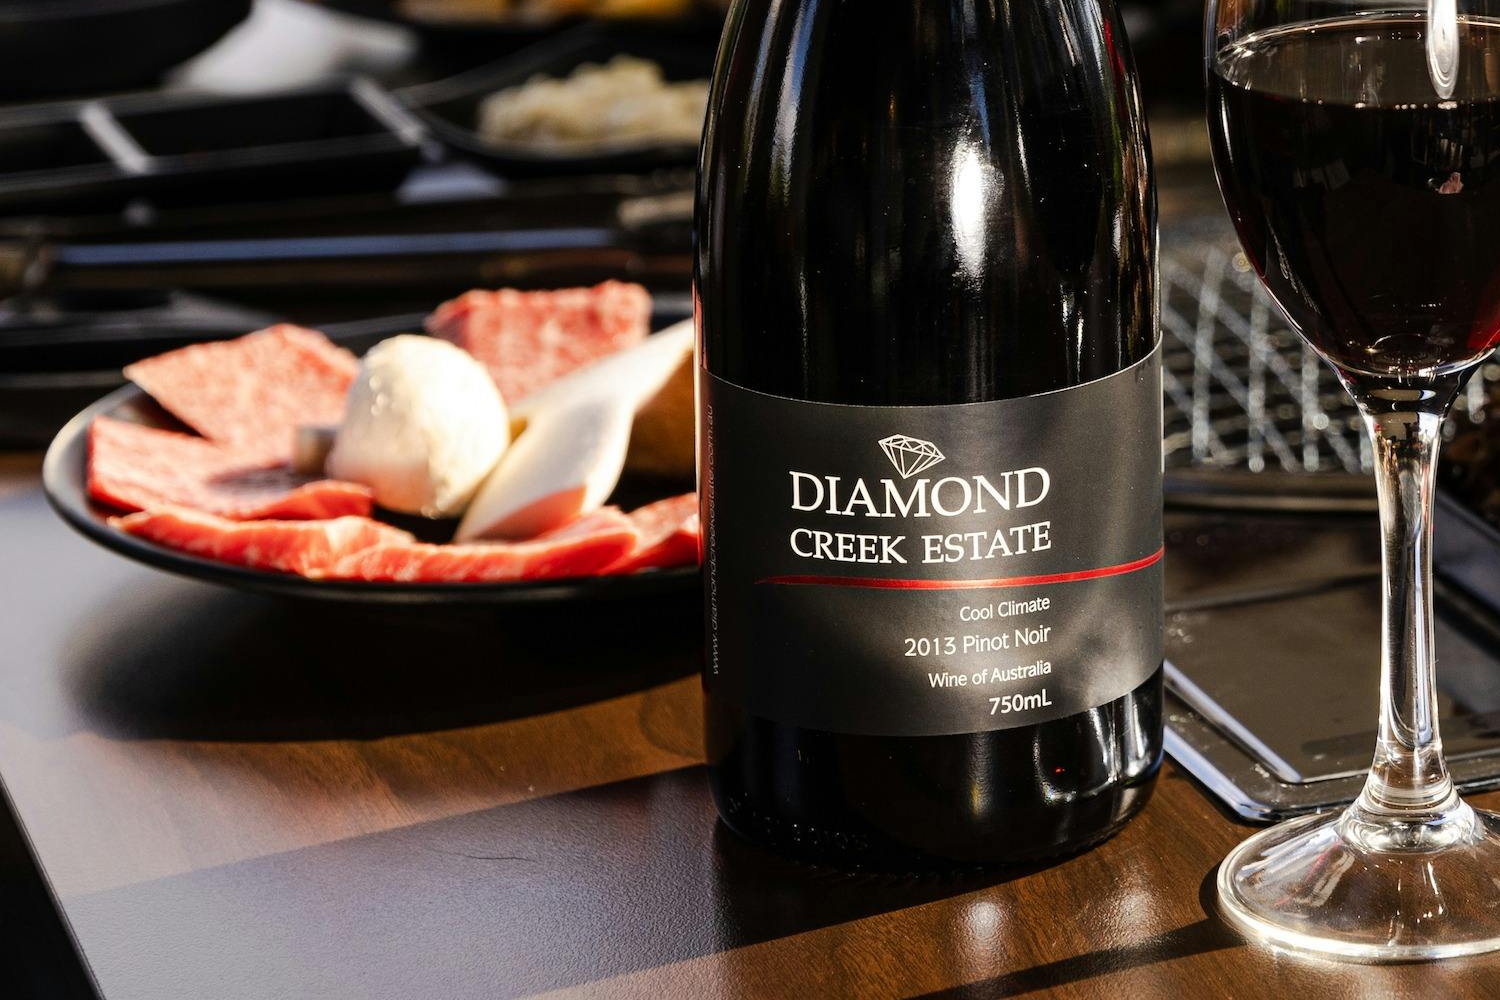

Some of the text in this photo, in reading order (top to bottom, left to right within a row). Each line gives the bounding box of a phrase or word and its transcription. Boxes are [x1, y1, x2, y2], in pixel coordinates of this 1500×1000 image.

[788, 466, 1051, 518] DIAMOND
[789, 521, 1052, 564] CREEK ESTATE
[959, 597, 1051, 622] Cool Climate
[904, 625, 1052, 657] 2013 Pinot Noir
[928, 659, 1052, 689] Wine of Australia
[988, 688, 1053, 716] 750mL
